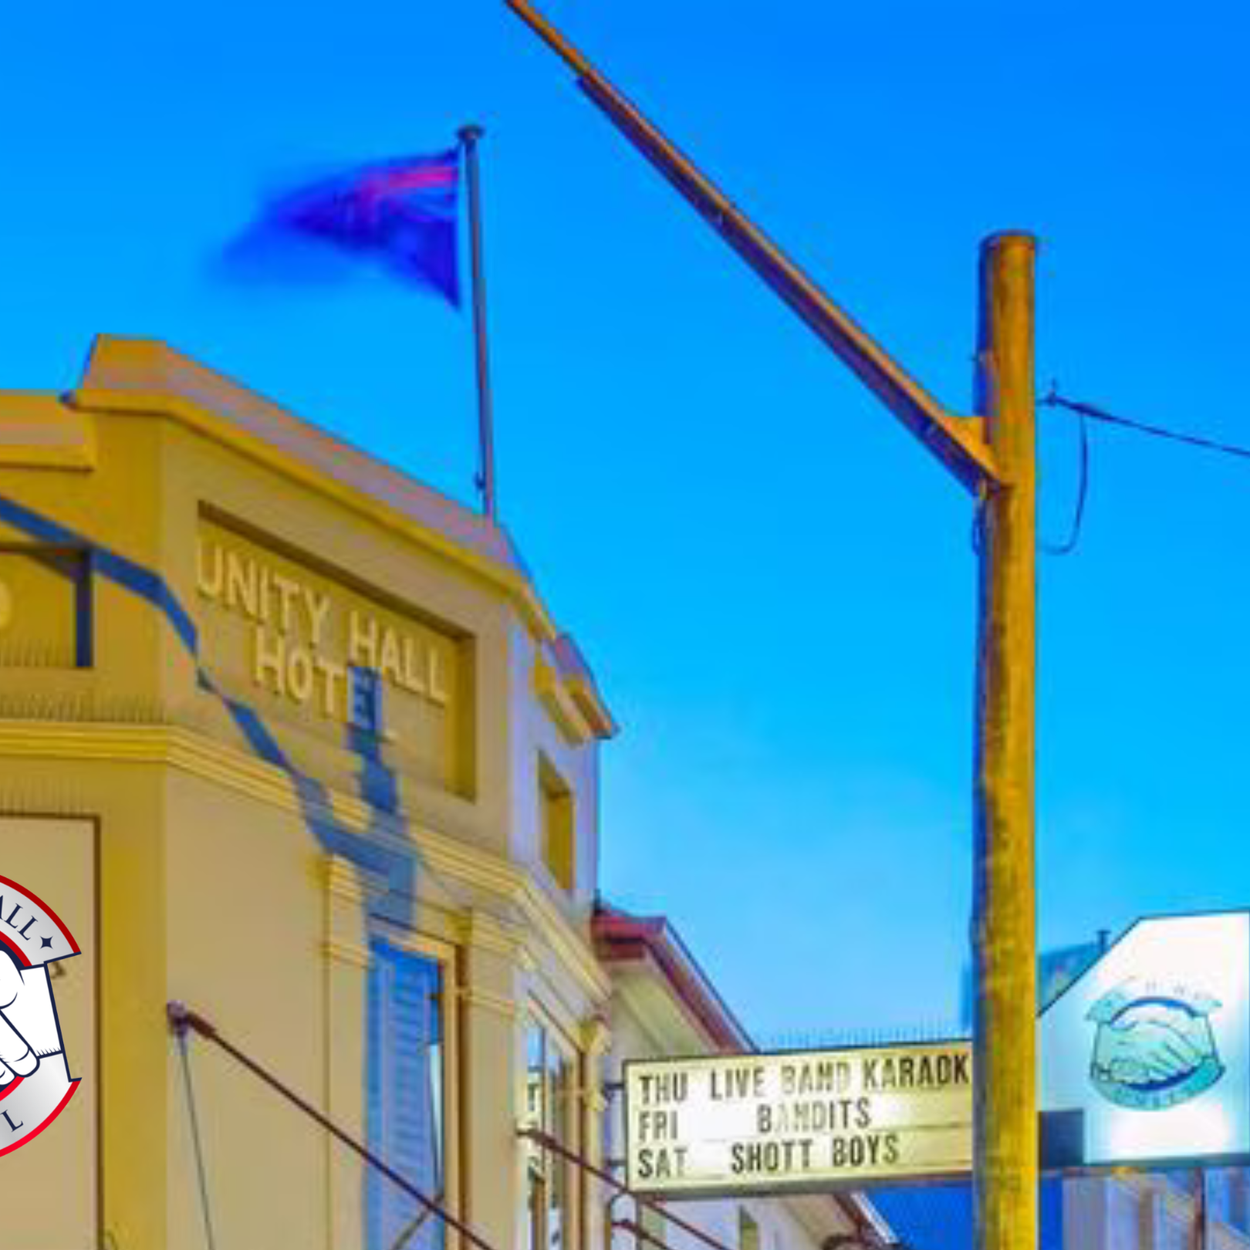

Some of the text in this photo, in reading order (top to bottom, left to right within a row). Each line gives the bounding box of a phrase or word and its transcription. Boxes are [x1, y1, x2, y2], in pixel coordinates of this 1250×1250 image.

[198, 545, 447, 708] UNITY HALL
[638, 1053, 969, 1105] THU LIVE BAND KARAOK
[638, 1097, 871, 1141] FRI BANDITS
[638, 1133, 899, 1179] SAT SHOTT BOYS
